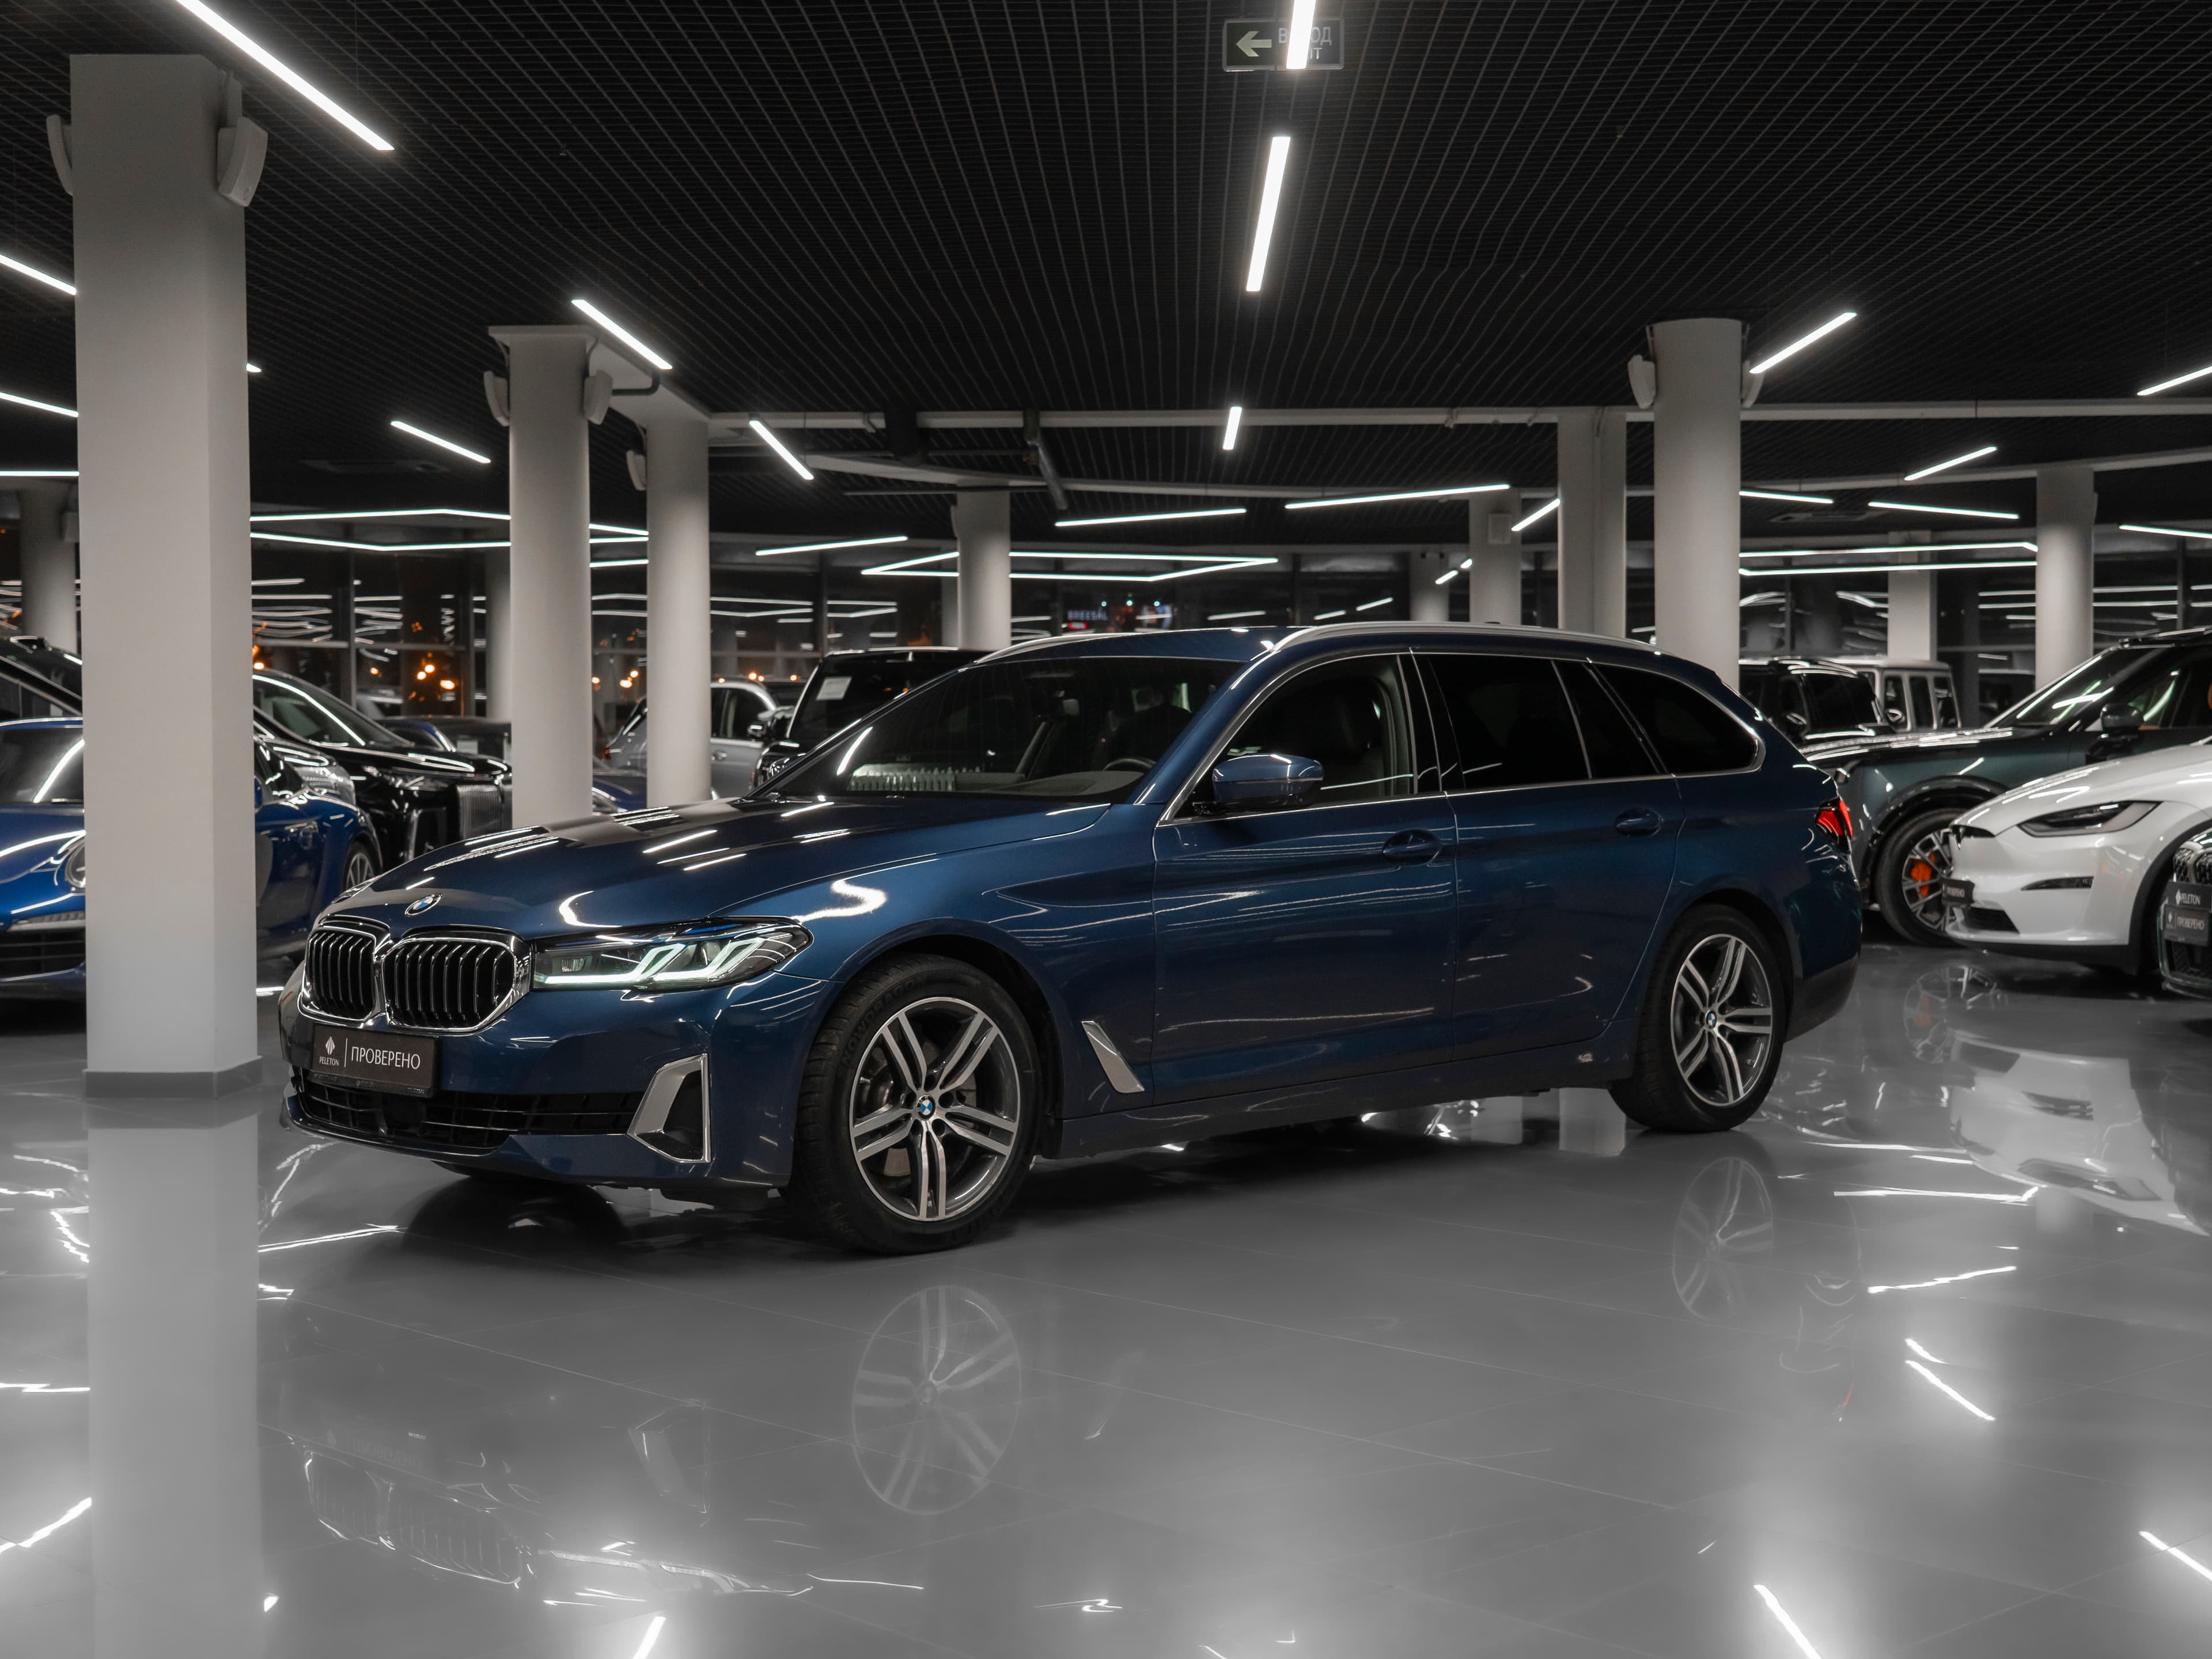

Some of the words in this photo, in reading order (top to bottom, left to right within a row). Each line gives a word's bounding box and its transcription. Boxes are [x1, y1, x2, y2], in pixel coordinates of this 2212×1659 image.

[1278, 27, 1332, 46] ВОД
[2181, 892, 2201, 905] PELETON
[319, 1056, 339, 1066] PELETON
[351, 1046, 421, 1070] ПРОВЕРЕНО
